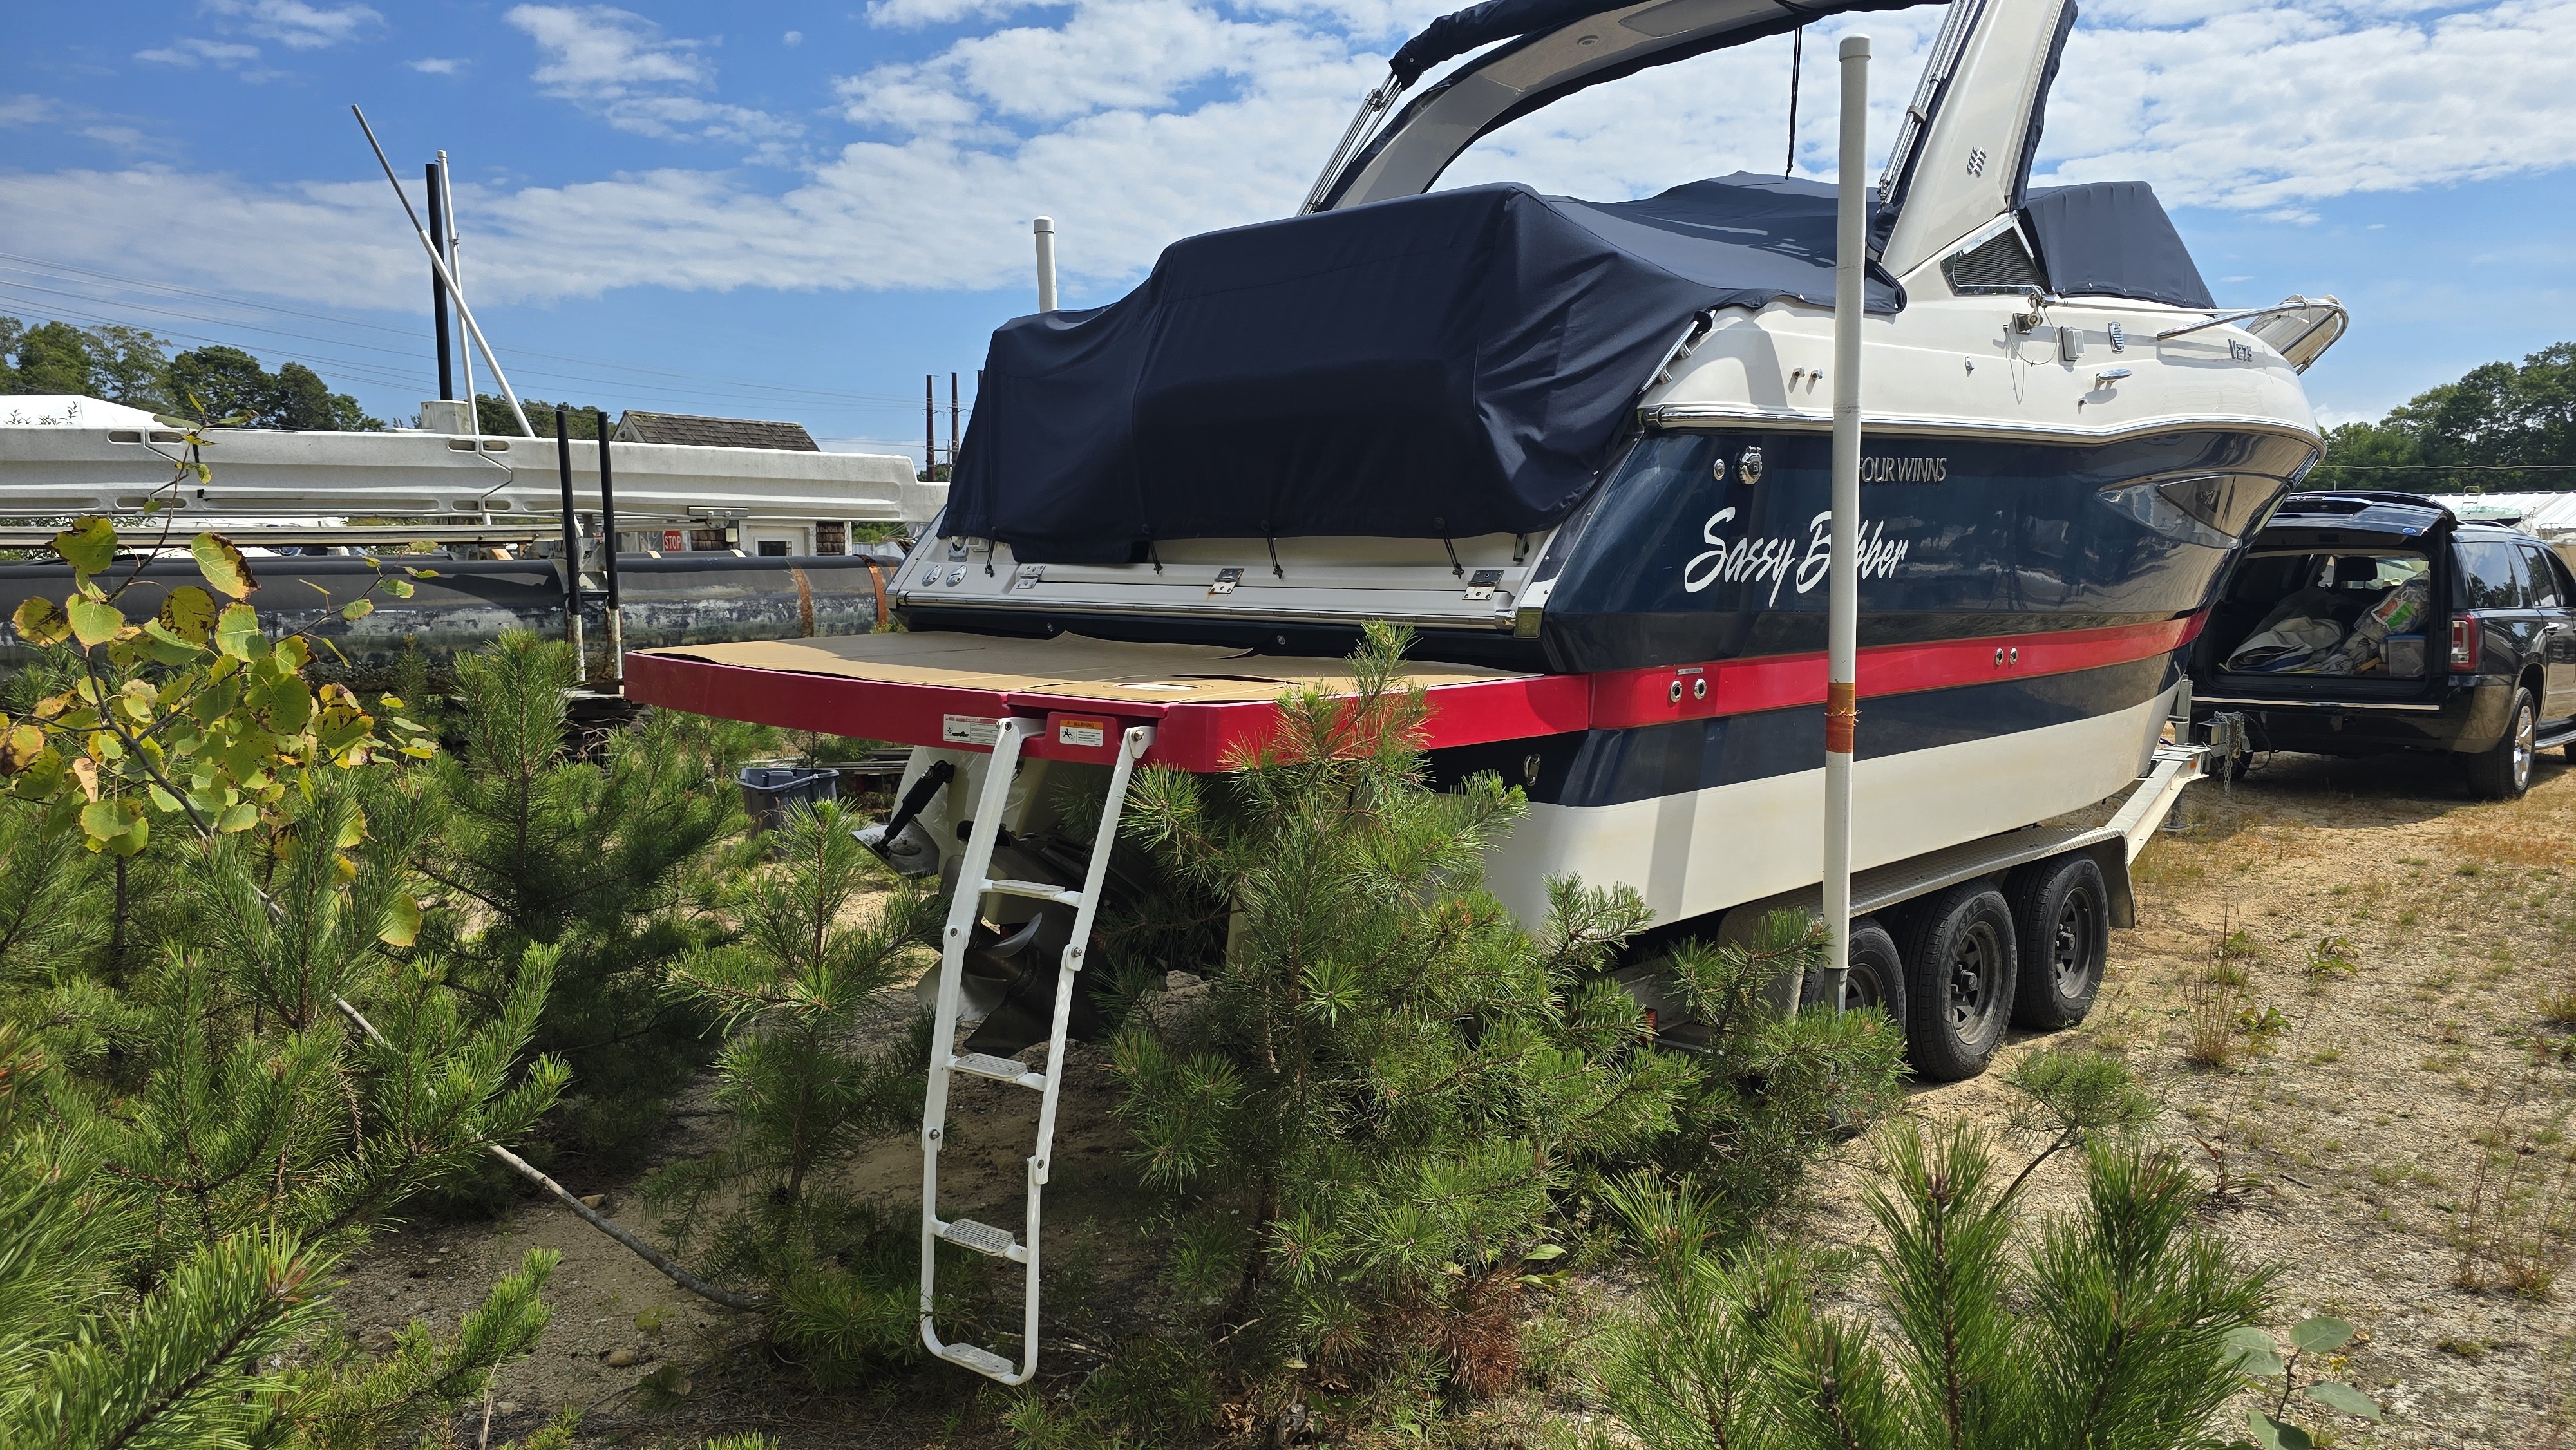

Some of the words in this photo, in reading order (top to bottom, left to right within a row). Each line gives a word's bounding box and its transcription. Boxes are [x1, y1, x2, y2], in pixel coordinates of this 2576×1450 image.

[2228, 339, 2253, 362] V275
[1897, 457, 1947, 482] WINNS
[664, 535, 681, 549] STOP
[1684, 506, 1796, 608] Sassy
[1796, 510, 1909, 594] Bbber
